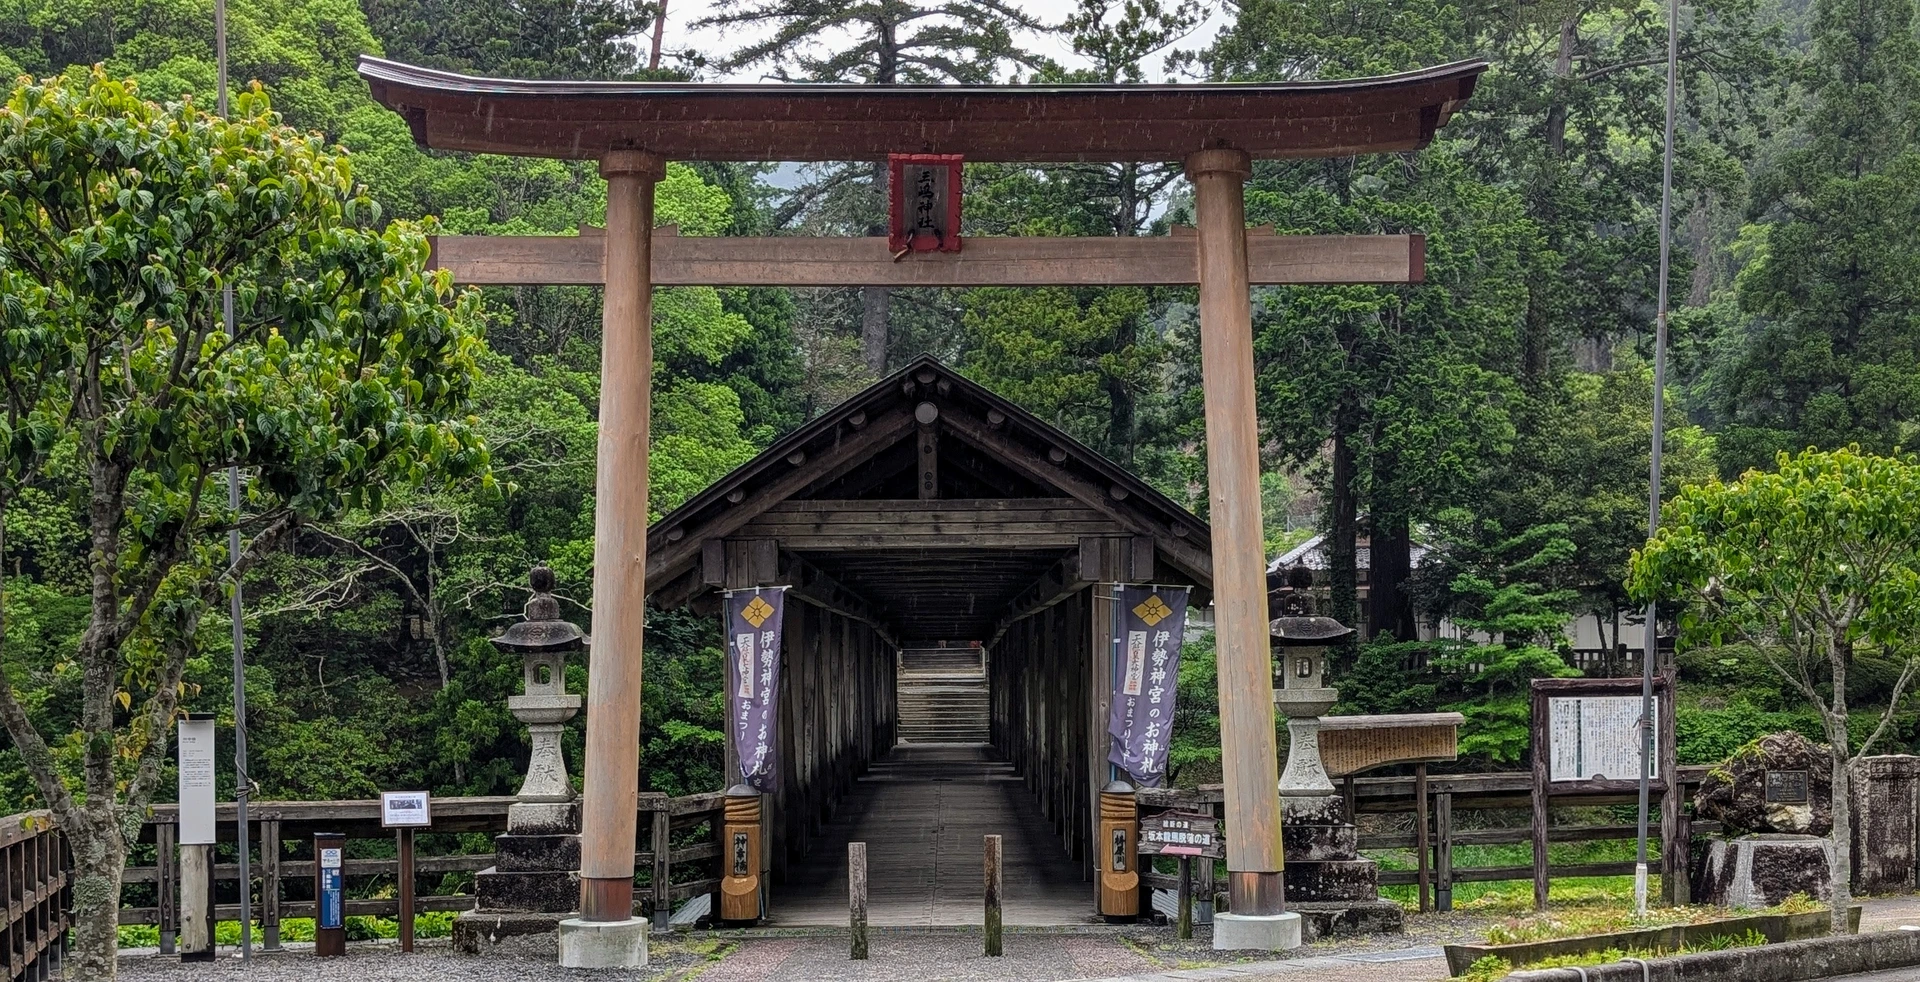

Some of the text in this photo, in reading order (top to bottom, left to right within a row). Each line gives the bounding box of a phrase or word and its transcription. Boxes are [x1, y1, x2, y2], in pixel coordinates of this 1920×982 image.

[1139, 629, 1171, 780] 伊勢神宮のお神札
